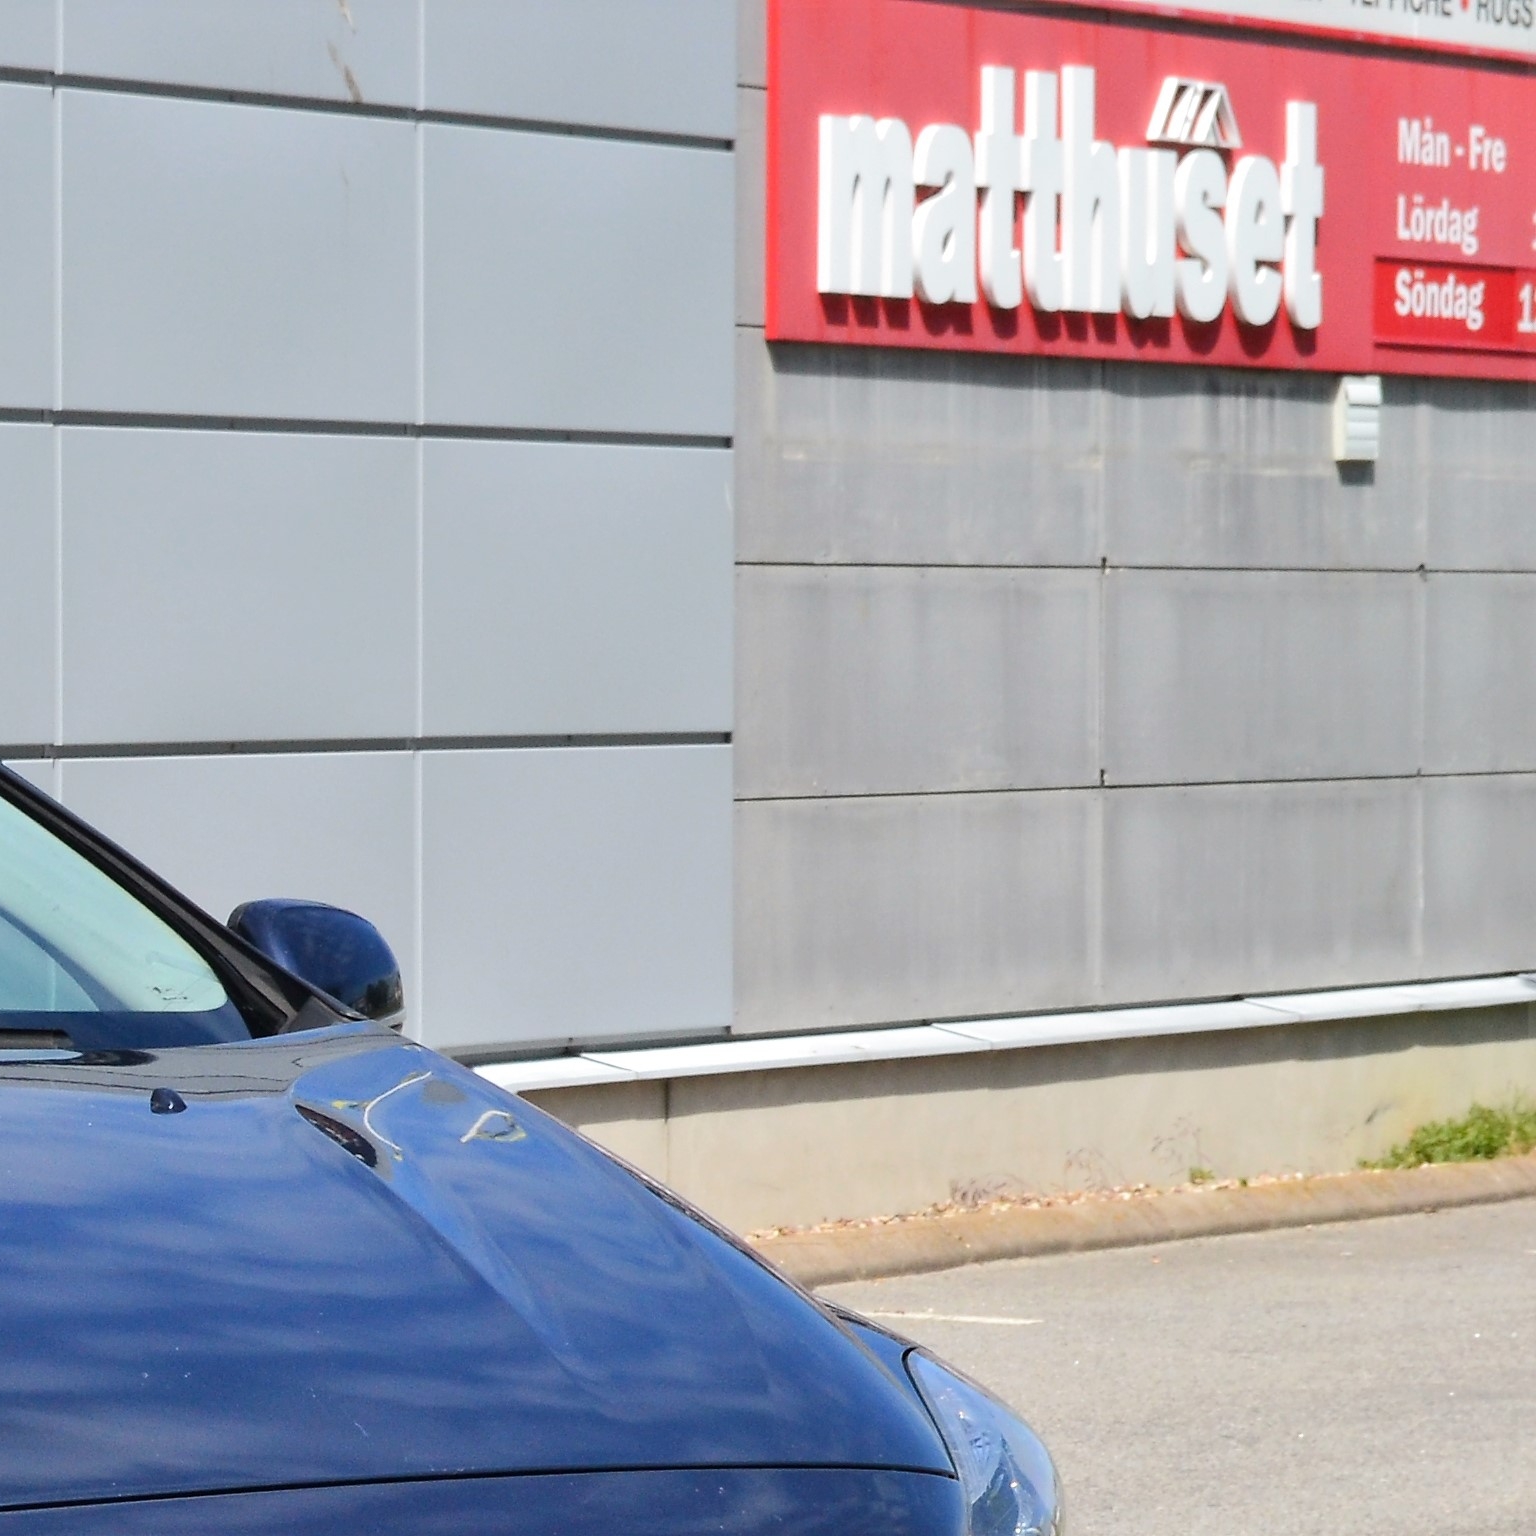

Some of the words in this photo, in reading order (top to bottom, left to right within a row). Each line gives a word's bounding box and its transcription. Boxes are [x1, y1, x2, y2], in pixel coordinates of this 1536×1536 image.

[1397, 116, 1451, 168] Mån
[1468, 125, 1507, 173] Fre
[818, 64, 1324, 330] matthuset
[1396, 194, 1480, 256] Lördag
[1393, 267, 1485, 331] Söndag
